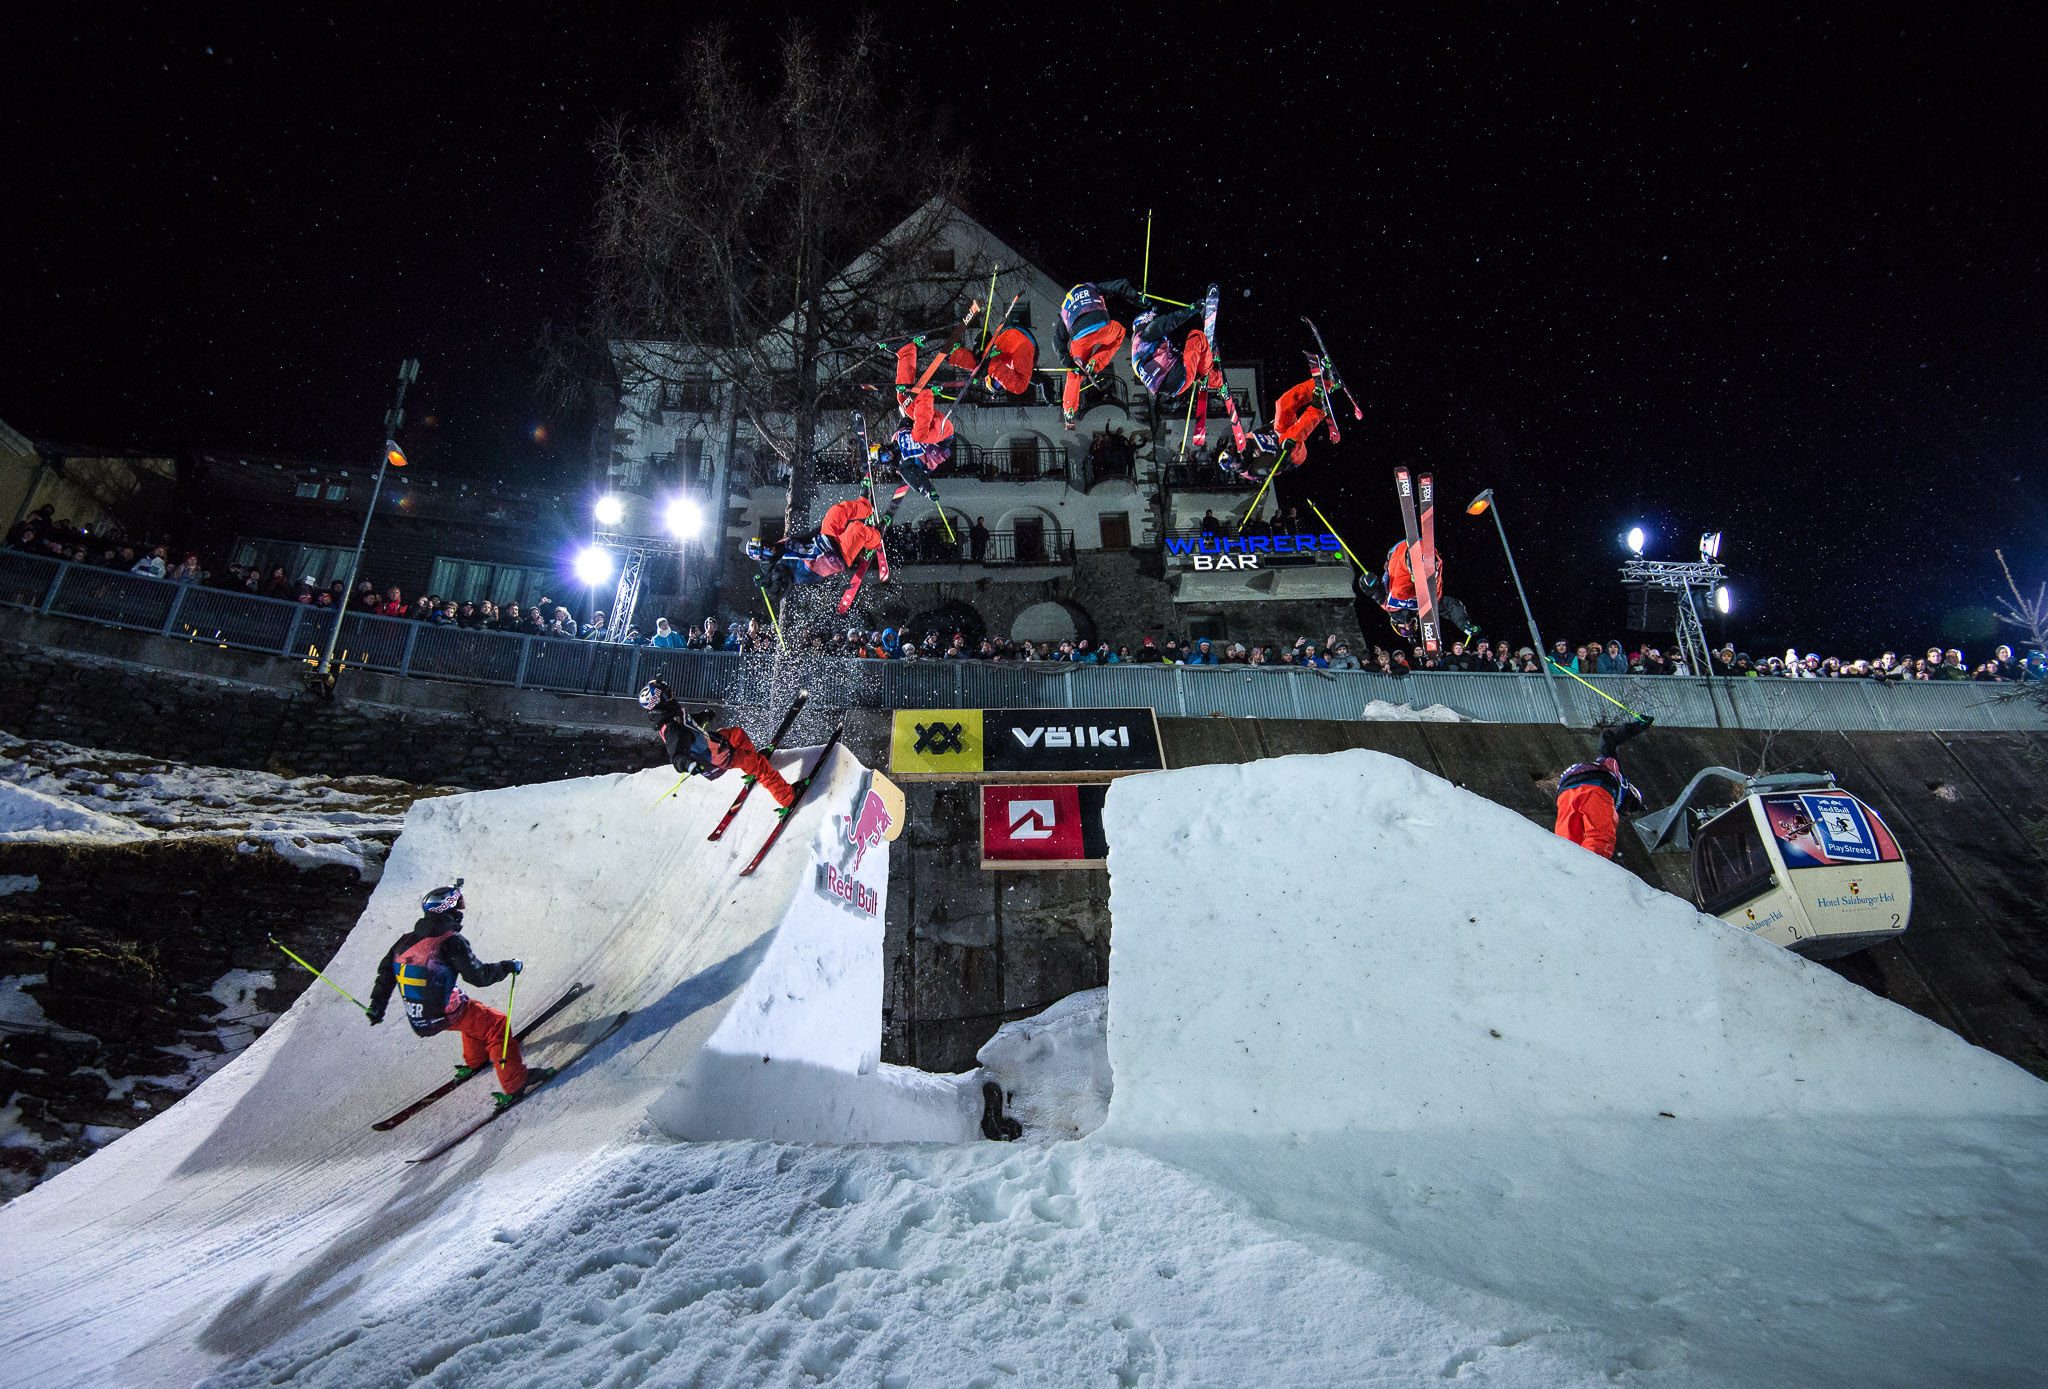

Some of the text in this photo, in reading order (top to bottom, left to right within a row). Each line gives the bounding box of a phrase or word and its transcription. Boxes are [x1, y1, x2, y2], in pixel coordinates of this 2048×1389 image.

[1398, 479, 1411, 497] head
[1420, 485, 1432, 502] head
[1165, 532, 1342, 554] WÜHRERS
[1193, 554, 1259, 570] BAR
[1423, 622, 1437, 641] head
[1011, 726, 1130, 748] Völkl
[1817, 805, 1850, 814] Red Bull
[827, 864, 878, 916] Red Bull
[1817, 892, 1895, 908] Hotel Salzburger Hof
[1771, 909, 1784, 923] Hof
[1890, 913, 1901, 929] 2
[1788, 926, 1803, 940] 2
